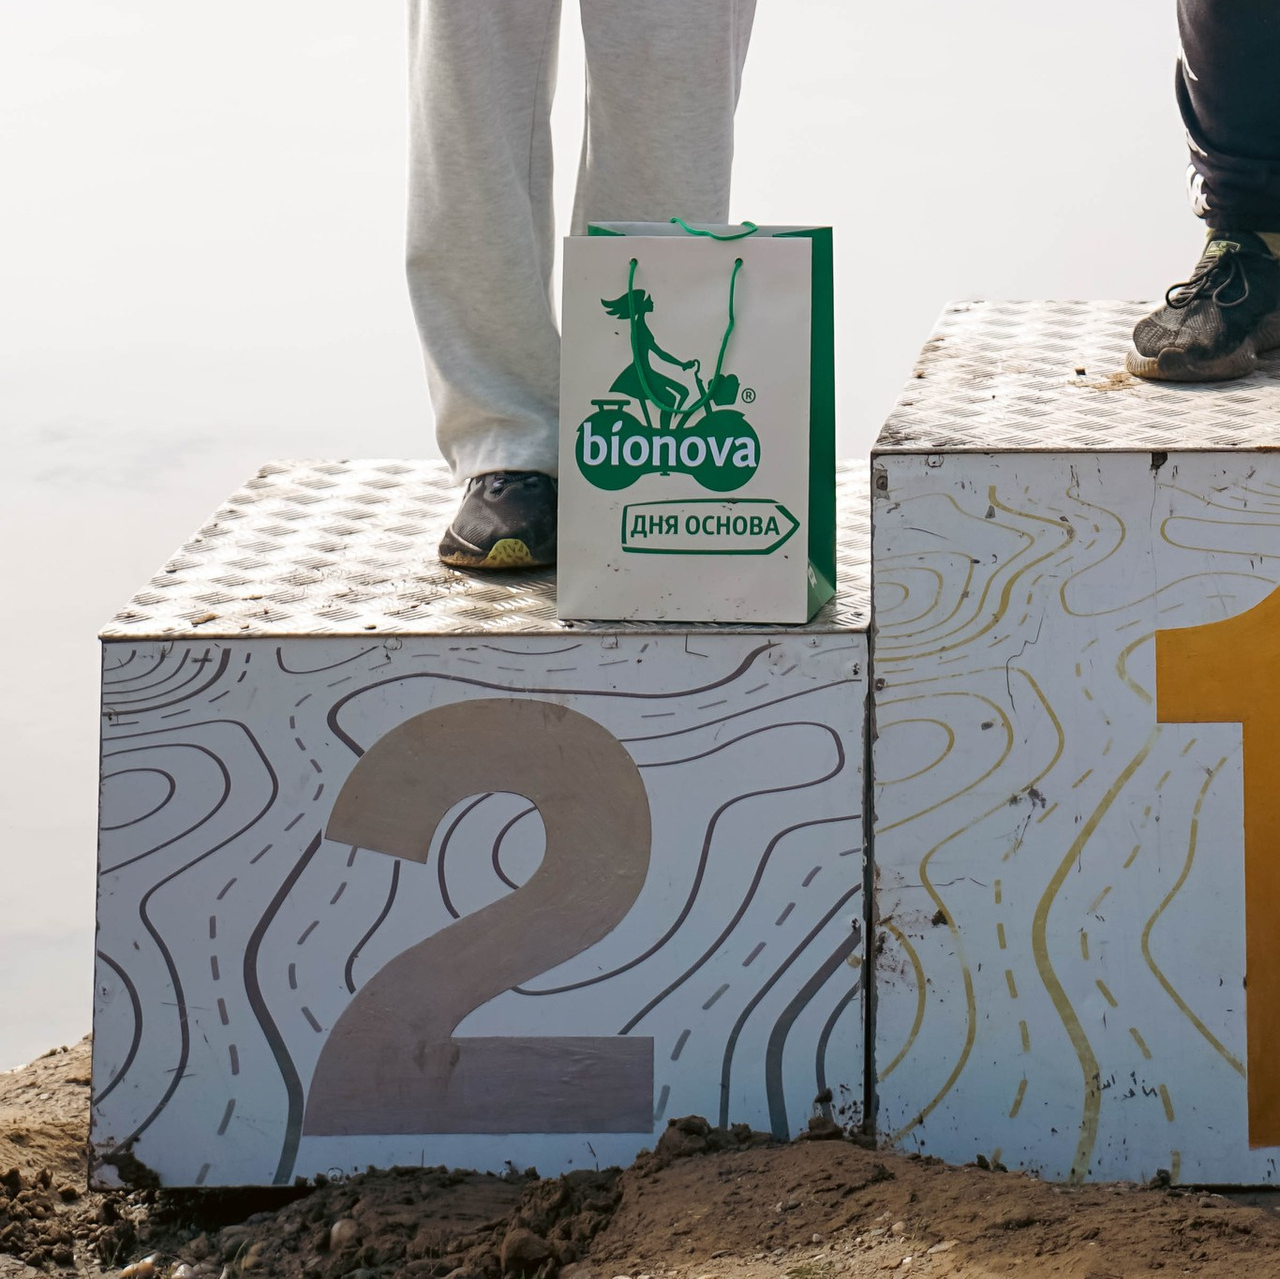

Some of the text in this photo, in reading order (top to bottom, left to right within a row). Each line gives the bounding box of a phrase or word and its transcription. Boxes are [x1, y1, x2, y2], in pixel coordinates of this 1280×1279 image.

[583, 420, 758, 469] bionova
[630, 514, 780, 538] ДНЯ ОСНОВА
[303, 697, 654, 1137] 2
